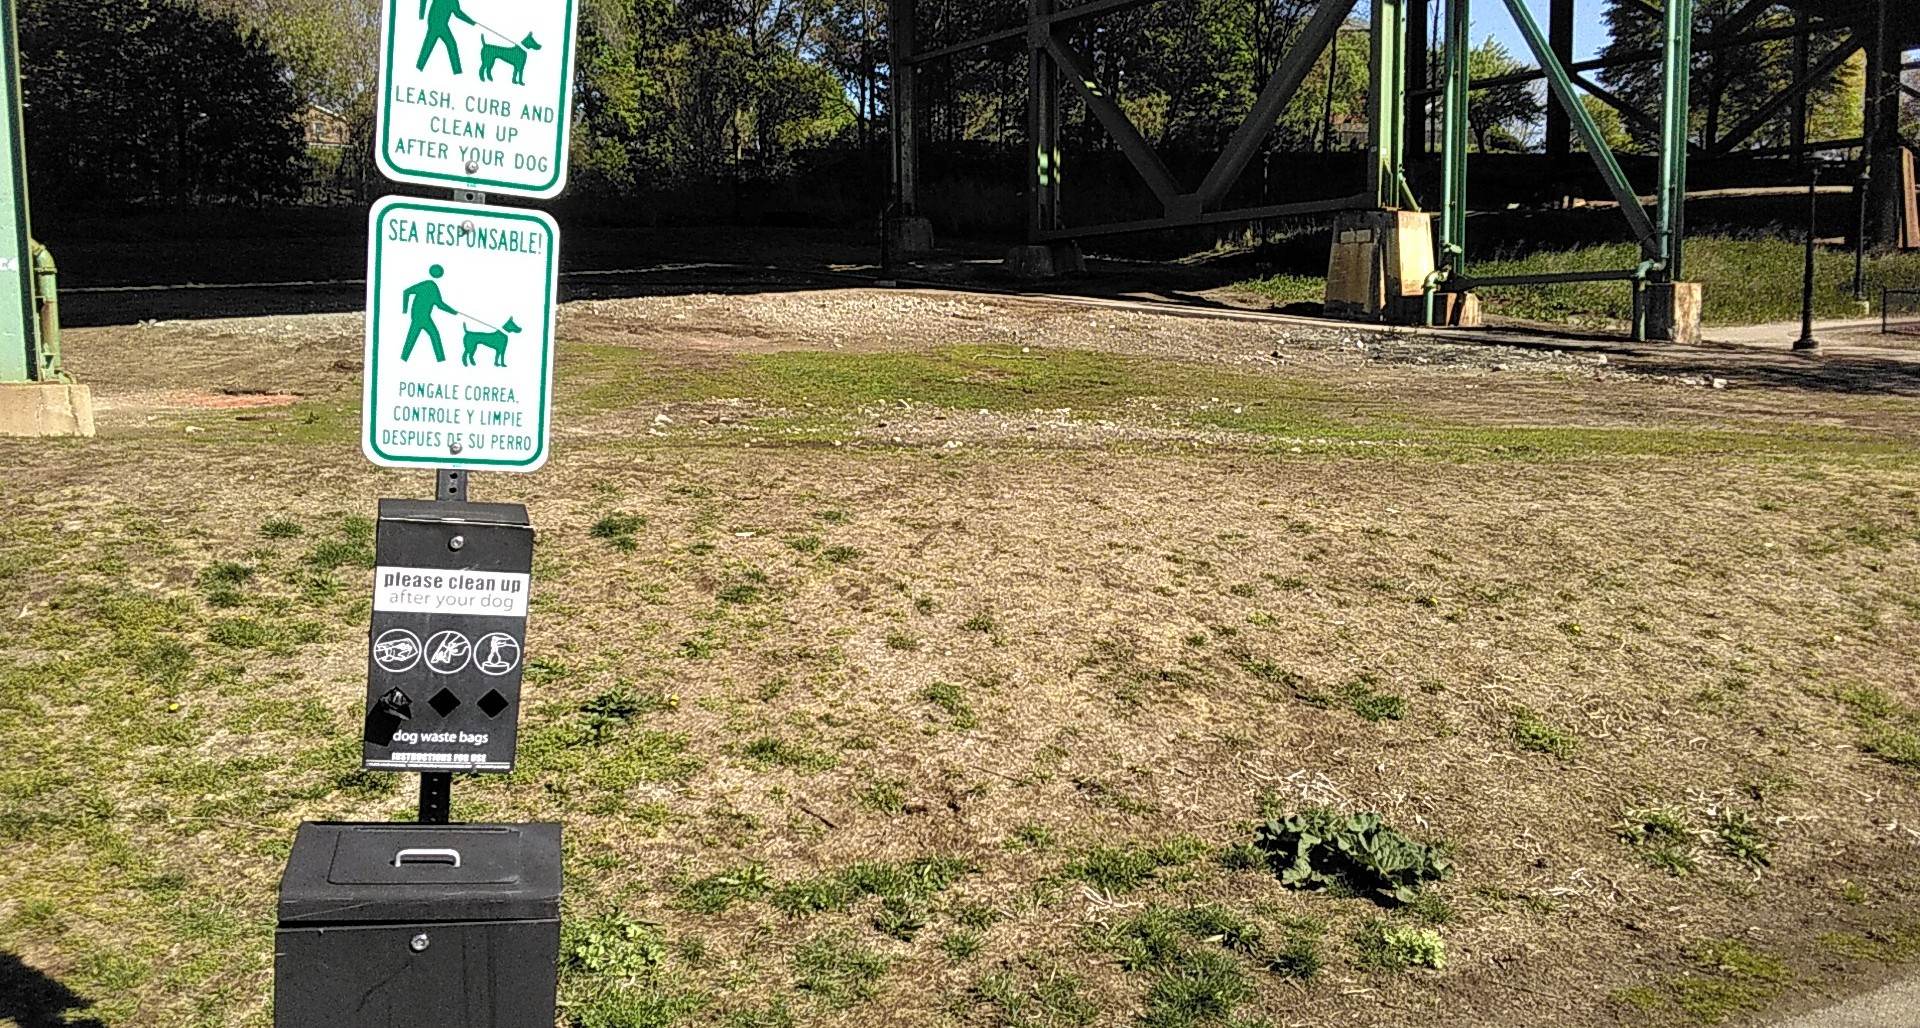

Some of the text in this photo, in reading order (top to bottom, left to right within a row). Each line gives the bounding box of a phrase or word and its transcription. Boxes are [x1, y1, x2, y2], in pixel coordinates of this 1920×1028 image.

[465, 95, 511, 117] CURB
[520, 104, 554, 124] AND
[429, 116, 518, 143] CLEAN UP
[395, 138, 548, 172] AFTER YOUR DOG
[388, 218, 542, 254] SEA RESPONSABLE!
[398, 381, 459, 399] PONGALE
[393, 406, 524, 427] CONTROLE Y LIMPIE
[382, 429, 532, 451] DESPUES DE SU PERRO
[384, 572, 521, 593] please clean up
[390, 589, 514, 612] after your dog
[393, 730, 489, 746] dog waste bags
